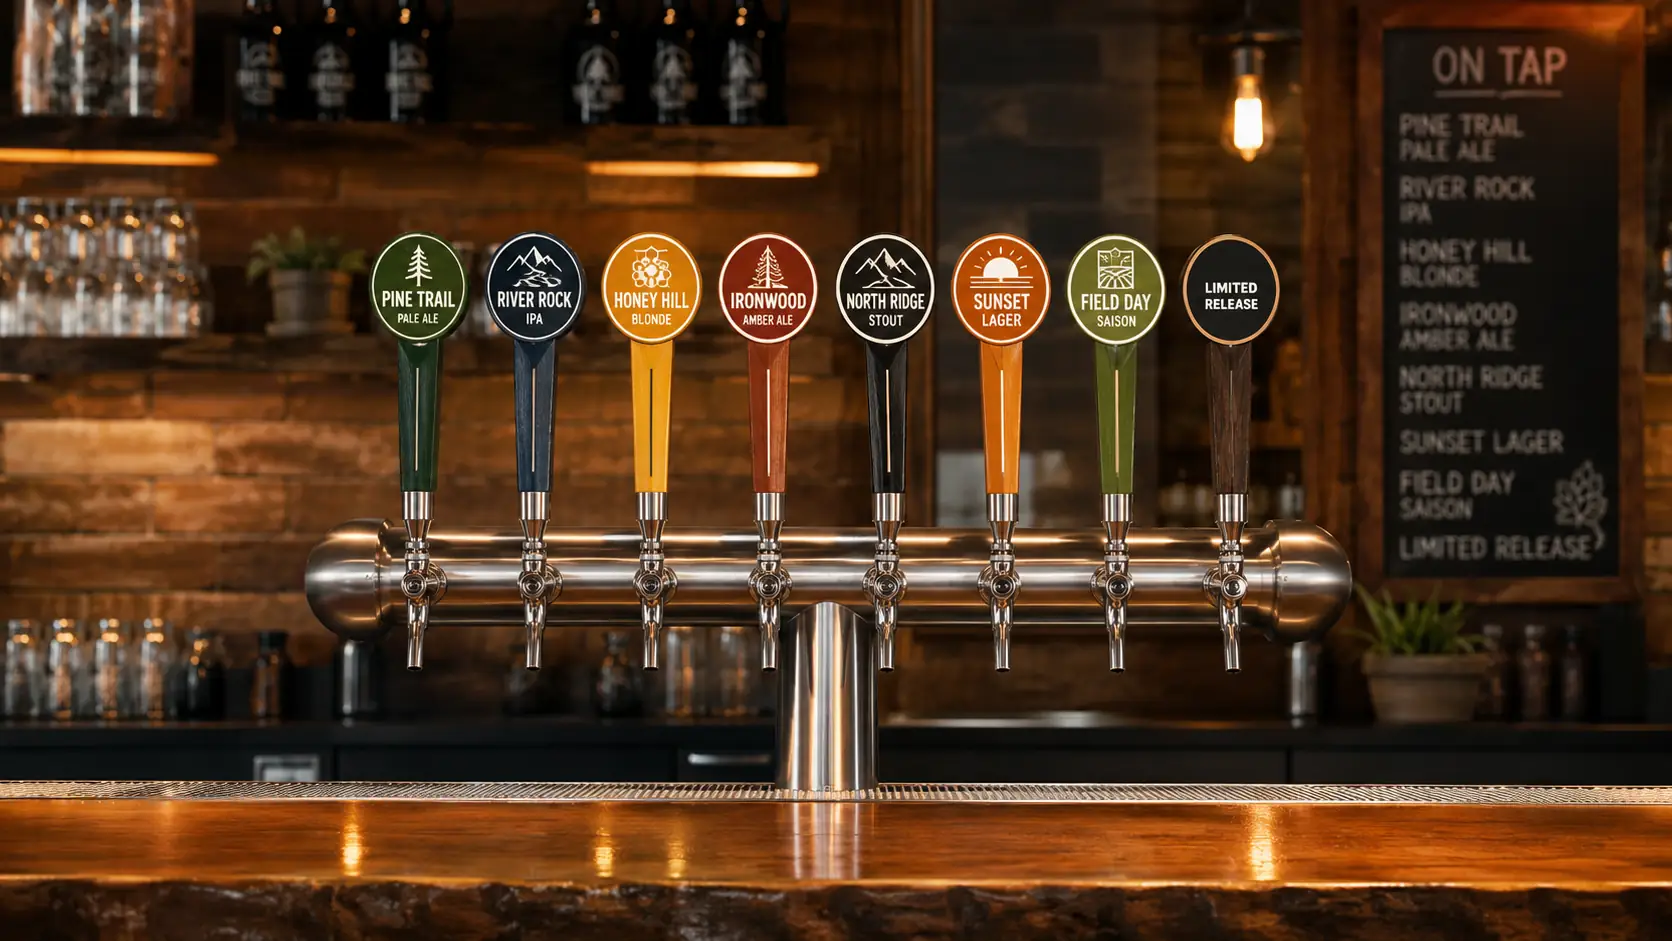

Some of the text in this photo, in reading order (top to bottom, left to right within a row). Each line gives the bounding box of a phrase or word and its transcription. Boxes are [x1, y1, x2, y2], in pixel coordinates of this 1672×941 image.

[1433, 46, 1567, 84] ON TAP
[1400, 114, 1524, 138] PINE TRAIL
[1400, 139, 1496, 162] PALE ALE
[1400, 175, 1536, 200] RIVER ROCK
[1400, 202, 1433, 224] IPA
[1400, 239, 1533, 264] HONEY HILL
[1400, 265, 1480, 288] BLONDE
[1206, 282, 1257, 293] LIMITED
[383, 291, 455, 307] PINE TRAIL
[498, 291, 571, 307] RIVER ROCK
[615, 292, 689, 308] HONEY HILL
[731, 293, 806, 309] IRONWOOD
[847, 293, 925, 309] NORTH RIDGE
[974, 293, 1030, 309] SUNSET
[1082, 294, 1151, 310] FIELD DAY
[1206, 299, 1258, 309] RELEASE
[398, 313, 438, 323] PALE ALE
[527, 313, 543, 324] IPA
[632, 314, 671, 325] BLONDE
[743, 315, 792, 325] AMBER ALE
[869, 314, 903, 326] STOUT
[983, 314, 1021, 326] LAGER
[1097, 315, 1136, 327] SAISON
[1400, 302, 1518, 326] IRONWOOD
[1399, 328, 1515, 350] AMBER ALE
[1399, 365, 1544, 389] NORTH RIDGE
[1400, 391, 1464, 414] STOUT
[1400, 429, 1564, 454] SUNSET LAGER
[1400, 470, 1516, 495] FIELD DAY
[1400, 498, 1474, 520] SAISON
[1400, 535, 1593, 560] LIMITED RELEASE
